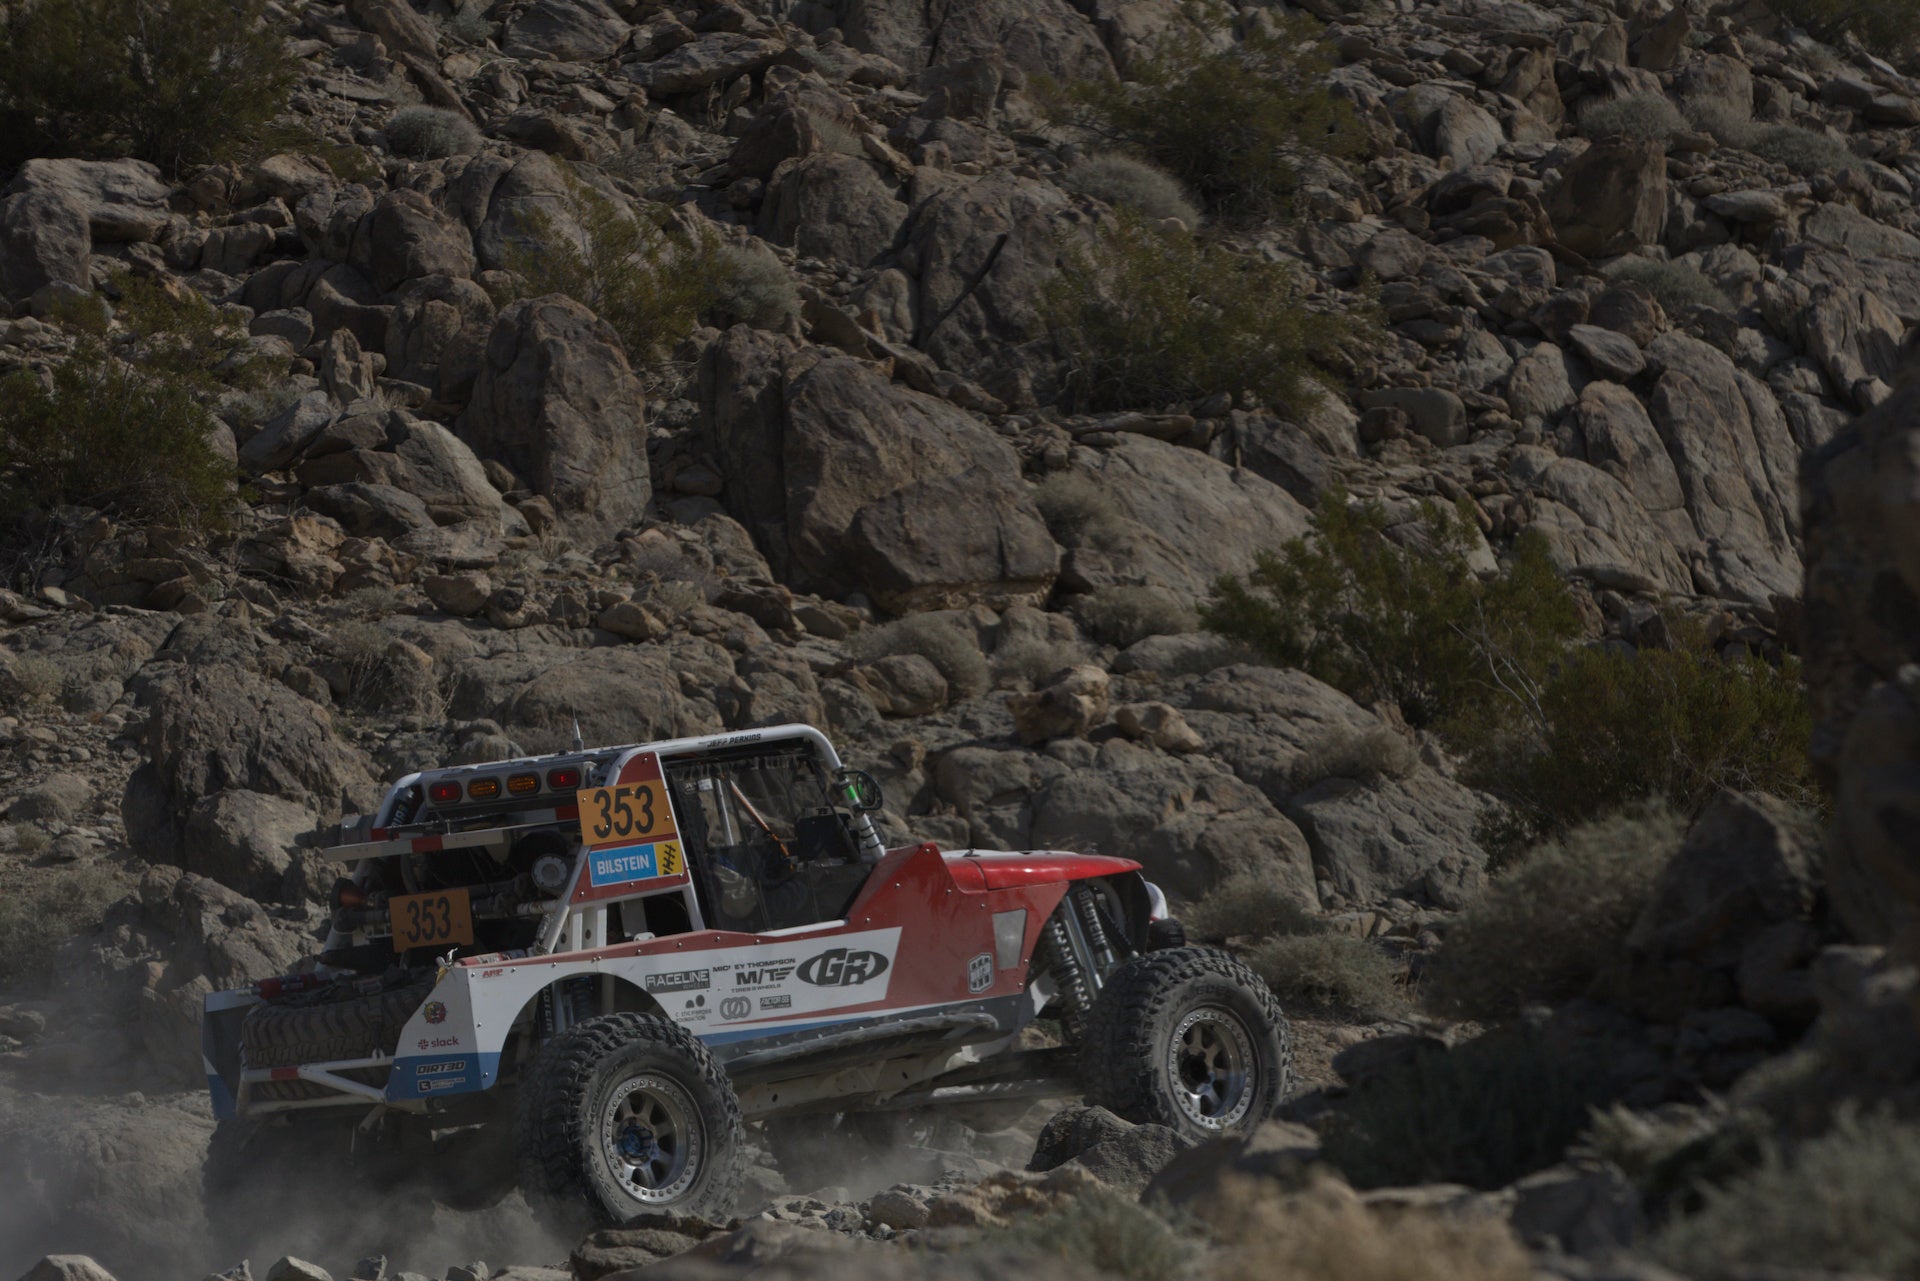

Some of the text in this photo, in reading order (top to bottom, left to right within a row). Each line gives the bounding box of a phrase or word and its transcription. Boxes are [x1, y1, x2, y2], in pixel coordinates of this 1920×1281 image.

[729, 733, 761, 745] PERKINS
[593, 785, 654, 838] 353
[596, 854, 650, 875] BILSTEIN
[406, 897, 451, 943] 353
[747, 958, 796, 968] THOMPSON
[646, 970, 709, 988] RACELINE
[431, 1036, 460, 1048] slack
